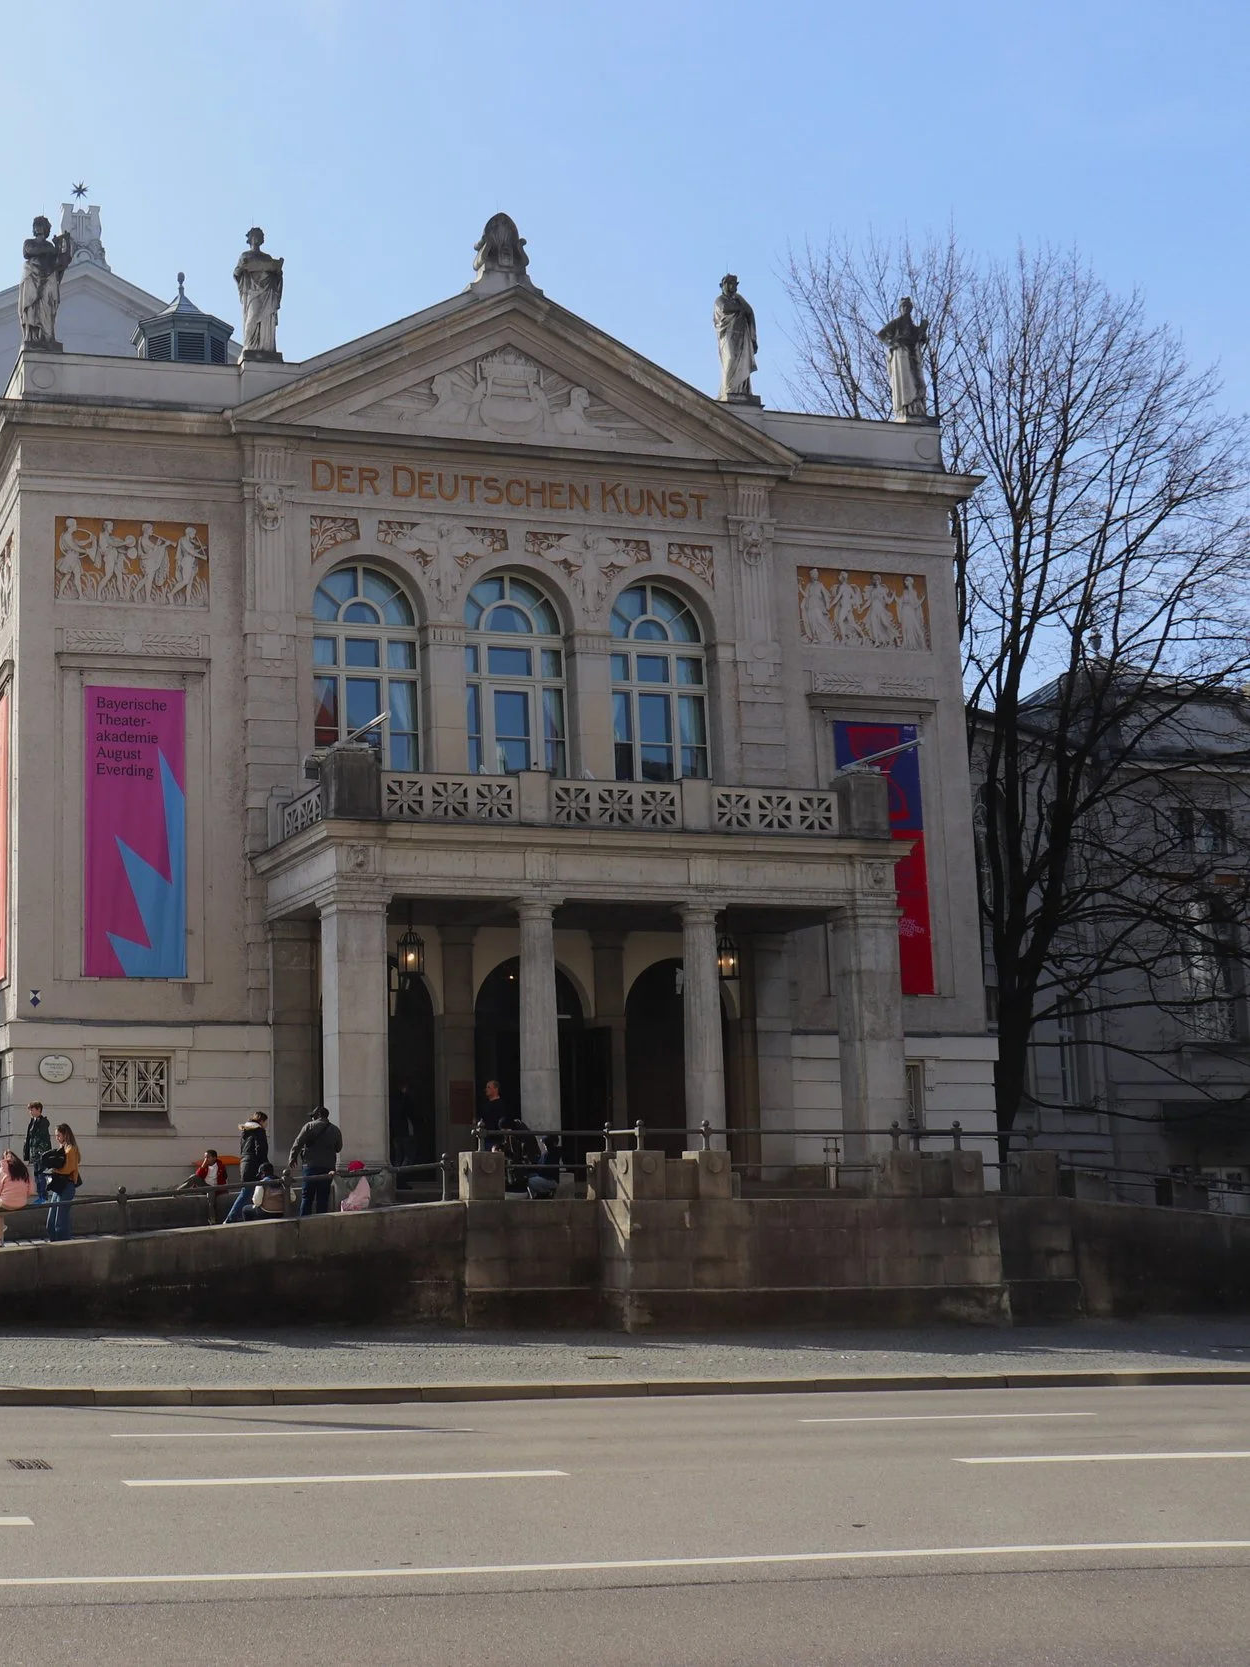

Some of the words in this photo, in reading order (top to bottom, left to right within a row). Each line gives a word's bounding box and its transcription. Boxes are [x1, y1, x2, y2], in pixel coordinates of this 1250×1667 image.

[310, 459, 380, 494] DER
[392, 465, 591, 511] DEUTSCHEN
[600, 482, 710, 520] KUNST
[96, 696, 167, 712] Bayerische
[96, 712, 151, 727] Theater-
[96, 729, 159, 744] akademie
[96, 746, 142, 762] August
[96, 763, 154, 780] Everding
